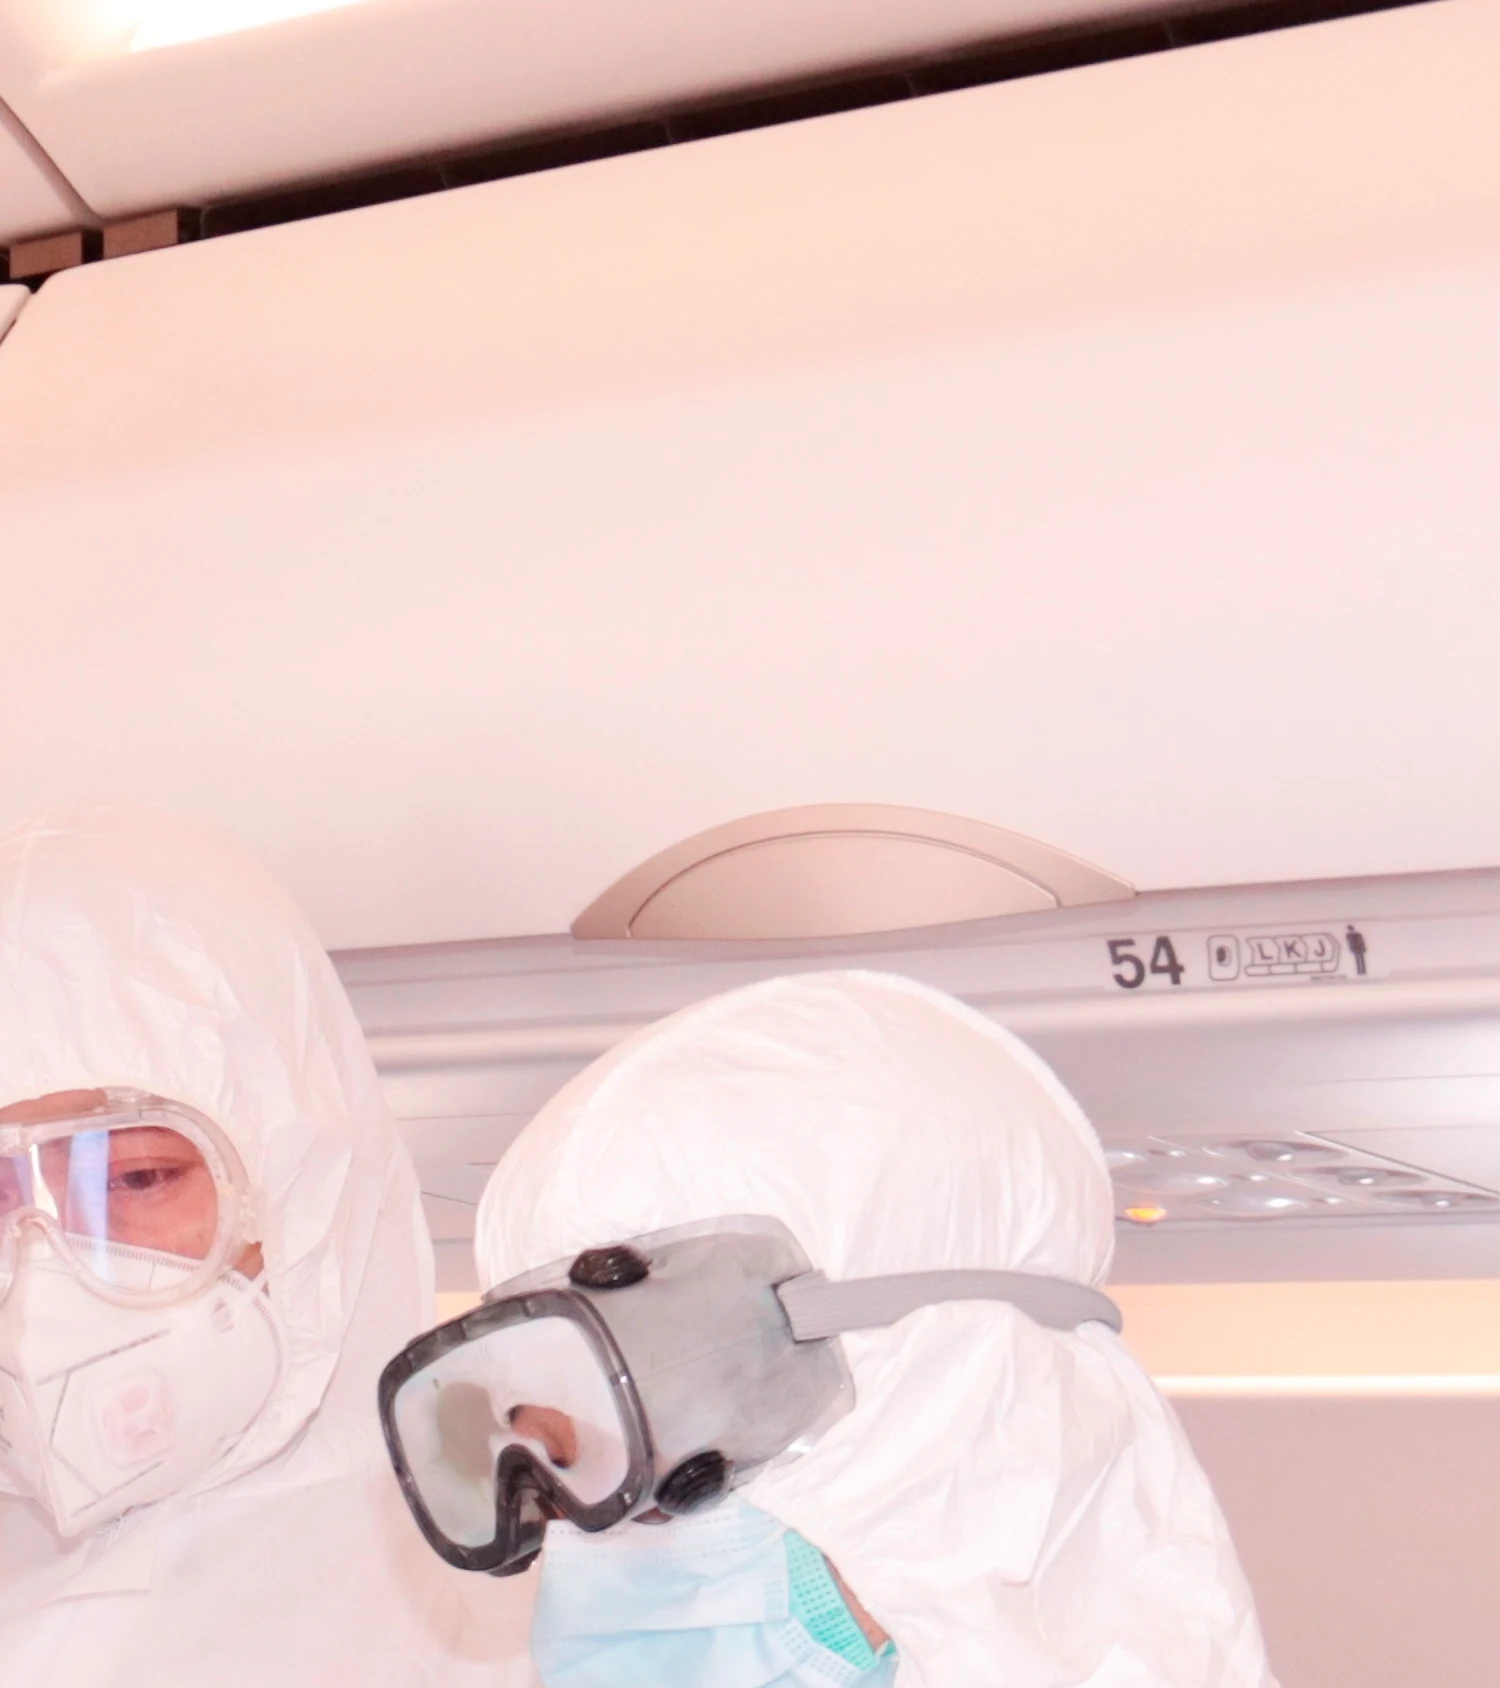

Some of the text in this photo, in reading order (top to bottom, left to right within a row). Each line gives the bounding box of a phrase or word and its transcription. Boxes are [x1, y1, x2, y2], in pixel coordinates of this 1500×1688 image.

[1106, 935, 1326, 989] 54 L K J
